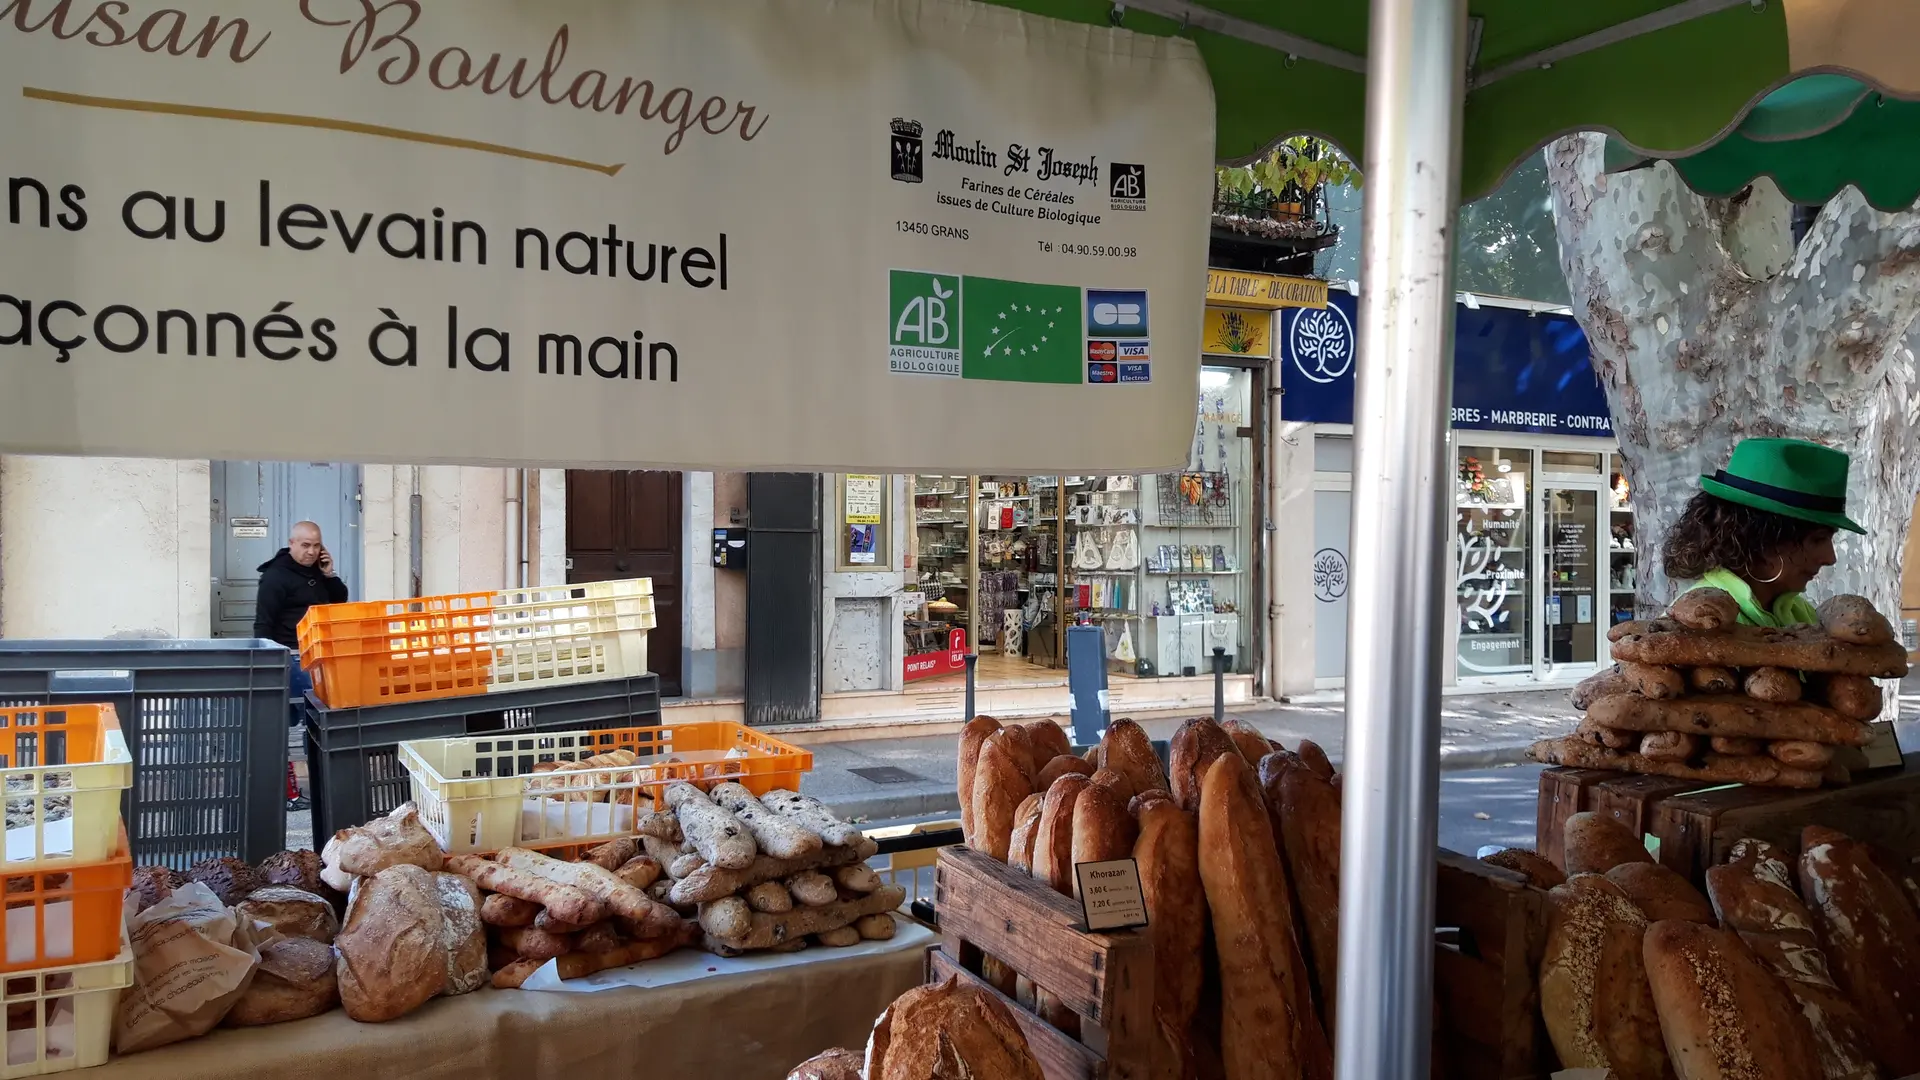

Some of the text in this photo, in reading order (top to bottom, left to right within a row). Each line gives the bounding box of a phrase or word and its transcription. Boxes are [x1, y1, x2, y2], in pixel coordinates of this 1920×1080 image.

[300, 0, 769, 155] Boulanger
[932, 129, 1099, 187] Moulin St Joseph
[961, 177, 1075, 205] Farines de Céréales
[1113, 174, 1140, 197] AB
[936, 192, 1101, 226] issues de Culture Biologique
[121, 190, 226, 243] au
[259, 180, 488, 265] levain
[515, 223, 728, 290] naturel
[896, 220, 969, 240] 13450 GRANS
[1038, 240, 1053, 253] Tél
[1214, 275, 1227, 294] LA
[1229, 276, 1260, 297] TABLE
[1267, 281, 1326, 304] DECORATION
[895, 295, 949, 345] AB
[367, 306, 417, 367] à
[448, 306, 510, 373] la
[538, 330, 679, 382] main
[1124, 347, 1145, 356] VISA
[890, 348, 960, 361] AGRICULTURE
[890, 360, 960, 373] BIOLOGIQUE
[1491, 410, 1558, 427] MARBRERIE
[1482, 519, 1520, 529] Humanité
[1486, 569, 1525, 580] Proximité
[1471, 639, 1520, 651] Engagement
[907, 662, 920, 672] POINT
